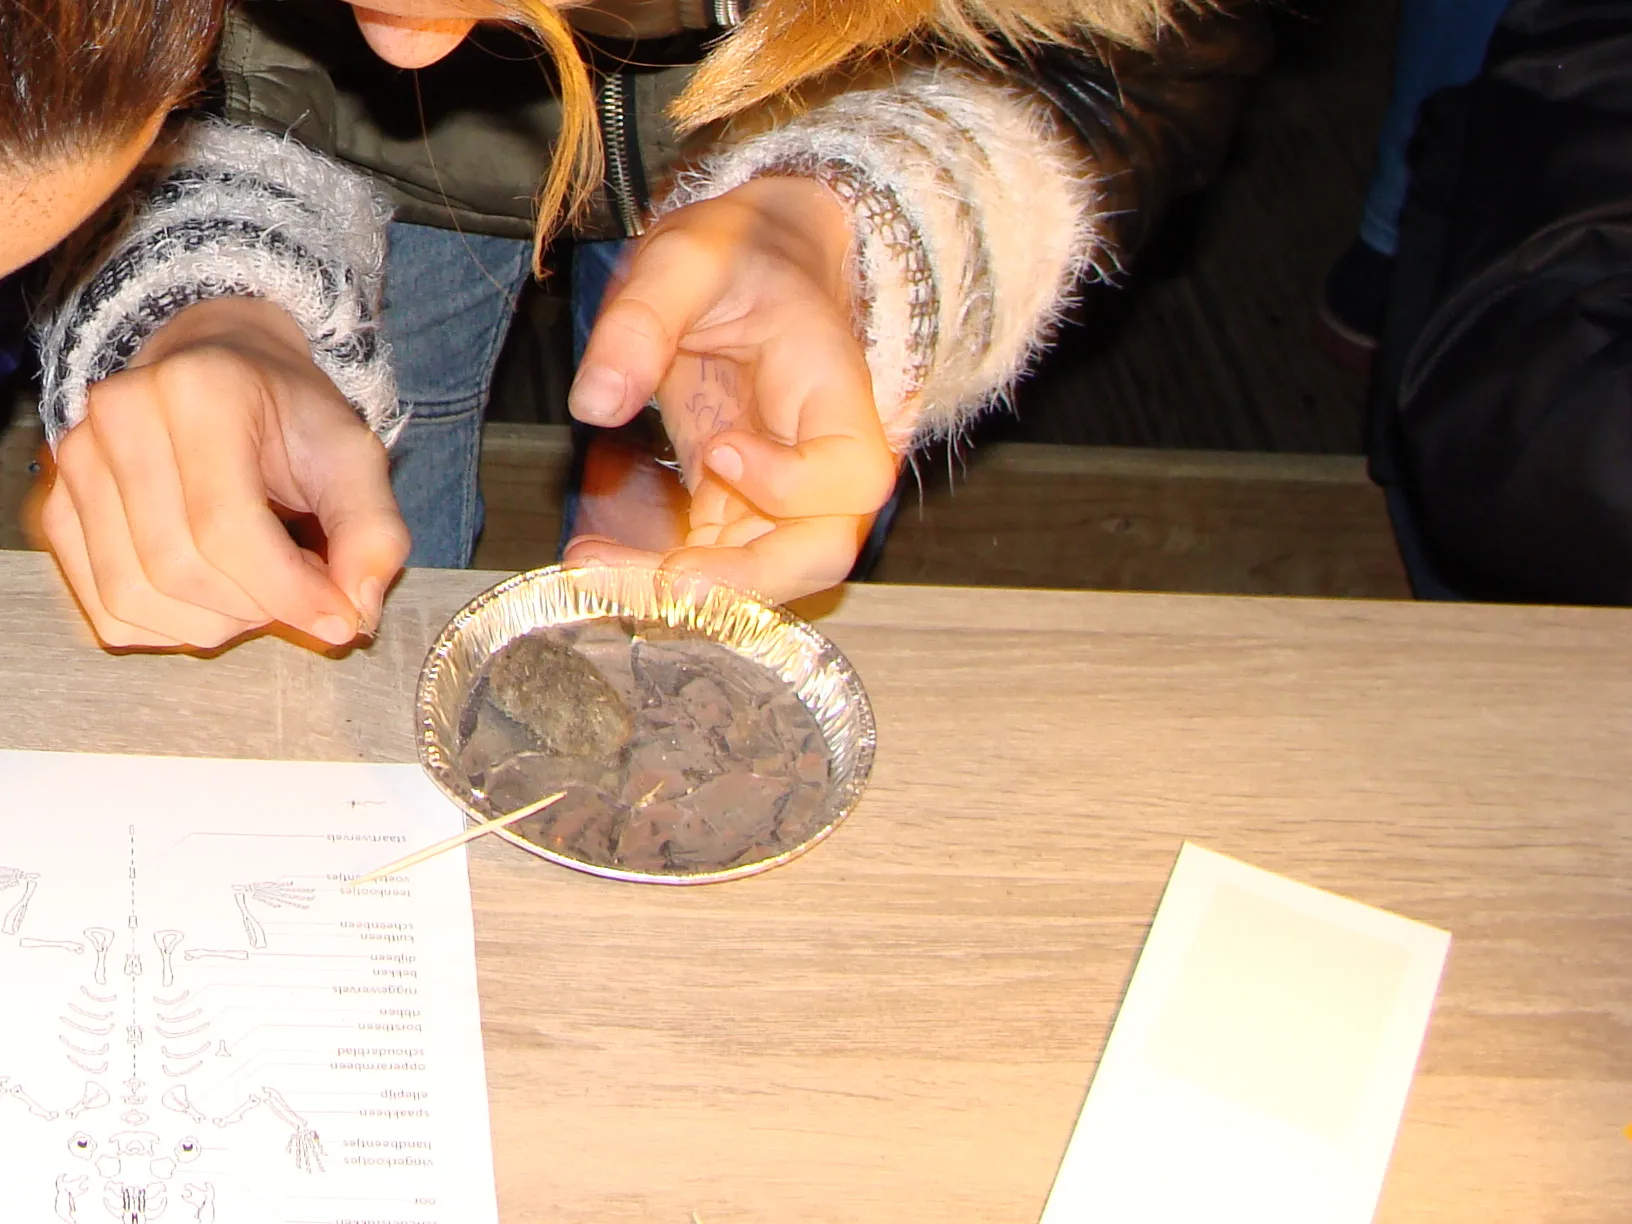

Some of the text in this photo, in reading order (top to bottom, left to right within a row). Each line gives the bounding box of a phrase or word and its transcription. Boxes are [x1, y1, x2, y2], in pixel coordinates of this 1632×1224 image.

[326, 834, 406, 843] staartwervels
[340, 921, 413, 930] scheenbeen
[360, 934, 414, 943] kuitbeen
[370, 953, 416, 964] dijbeen
[373, 969, 417, 978] bekken
[332, 985, 417, 995] ruggewervels
[380, 1009, 420, 1018] ribben
[358, 1023, 422, 1032] borstbeen
[337, 1047, 424, 1058] schouderblad
[330, 1062, 425, 1072] opperarmbeen
[381, 1090, 427, 1100] ellepijp
[359, 1109, 429, 1119] spaakbeen
[343, 1139, 431, 1151] handbeentjes
[344, 1156, 433, 1167] vingerkootjes
